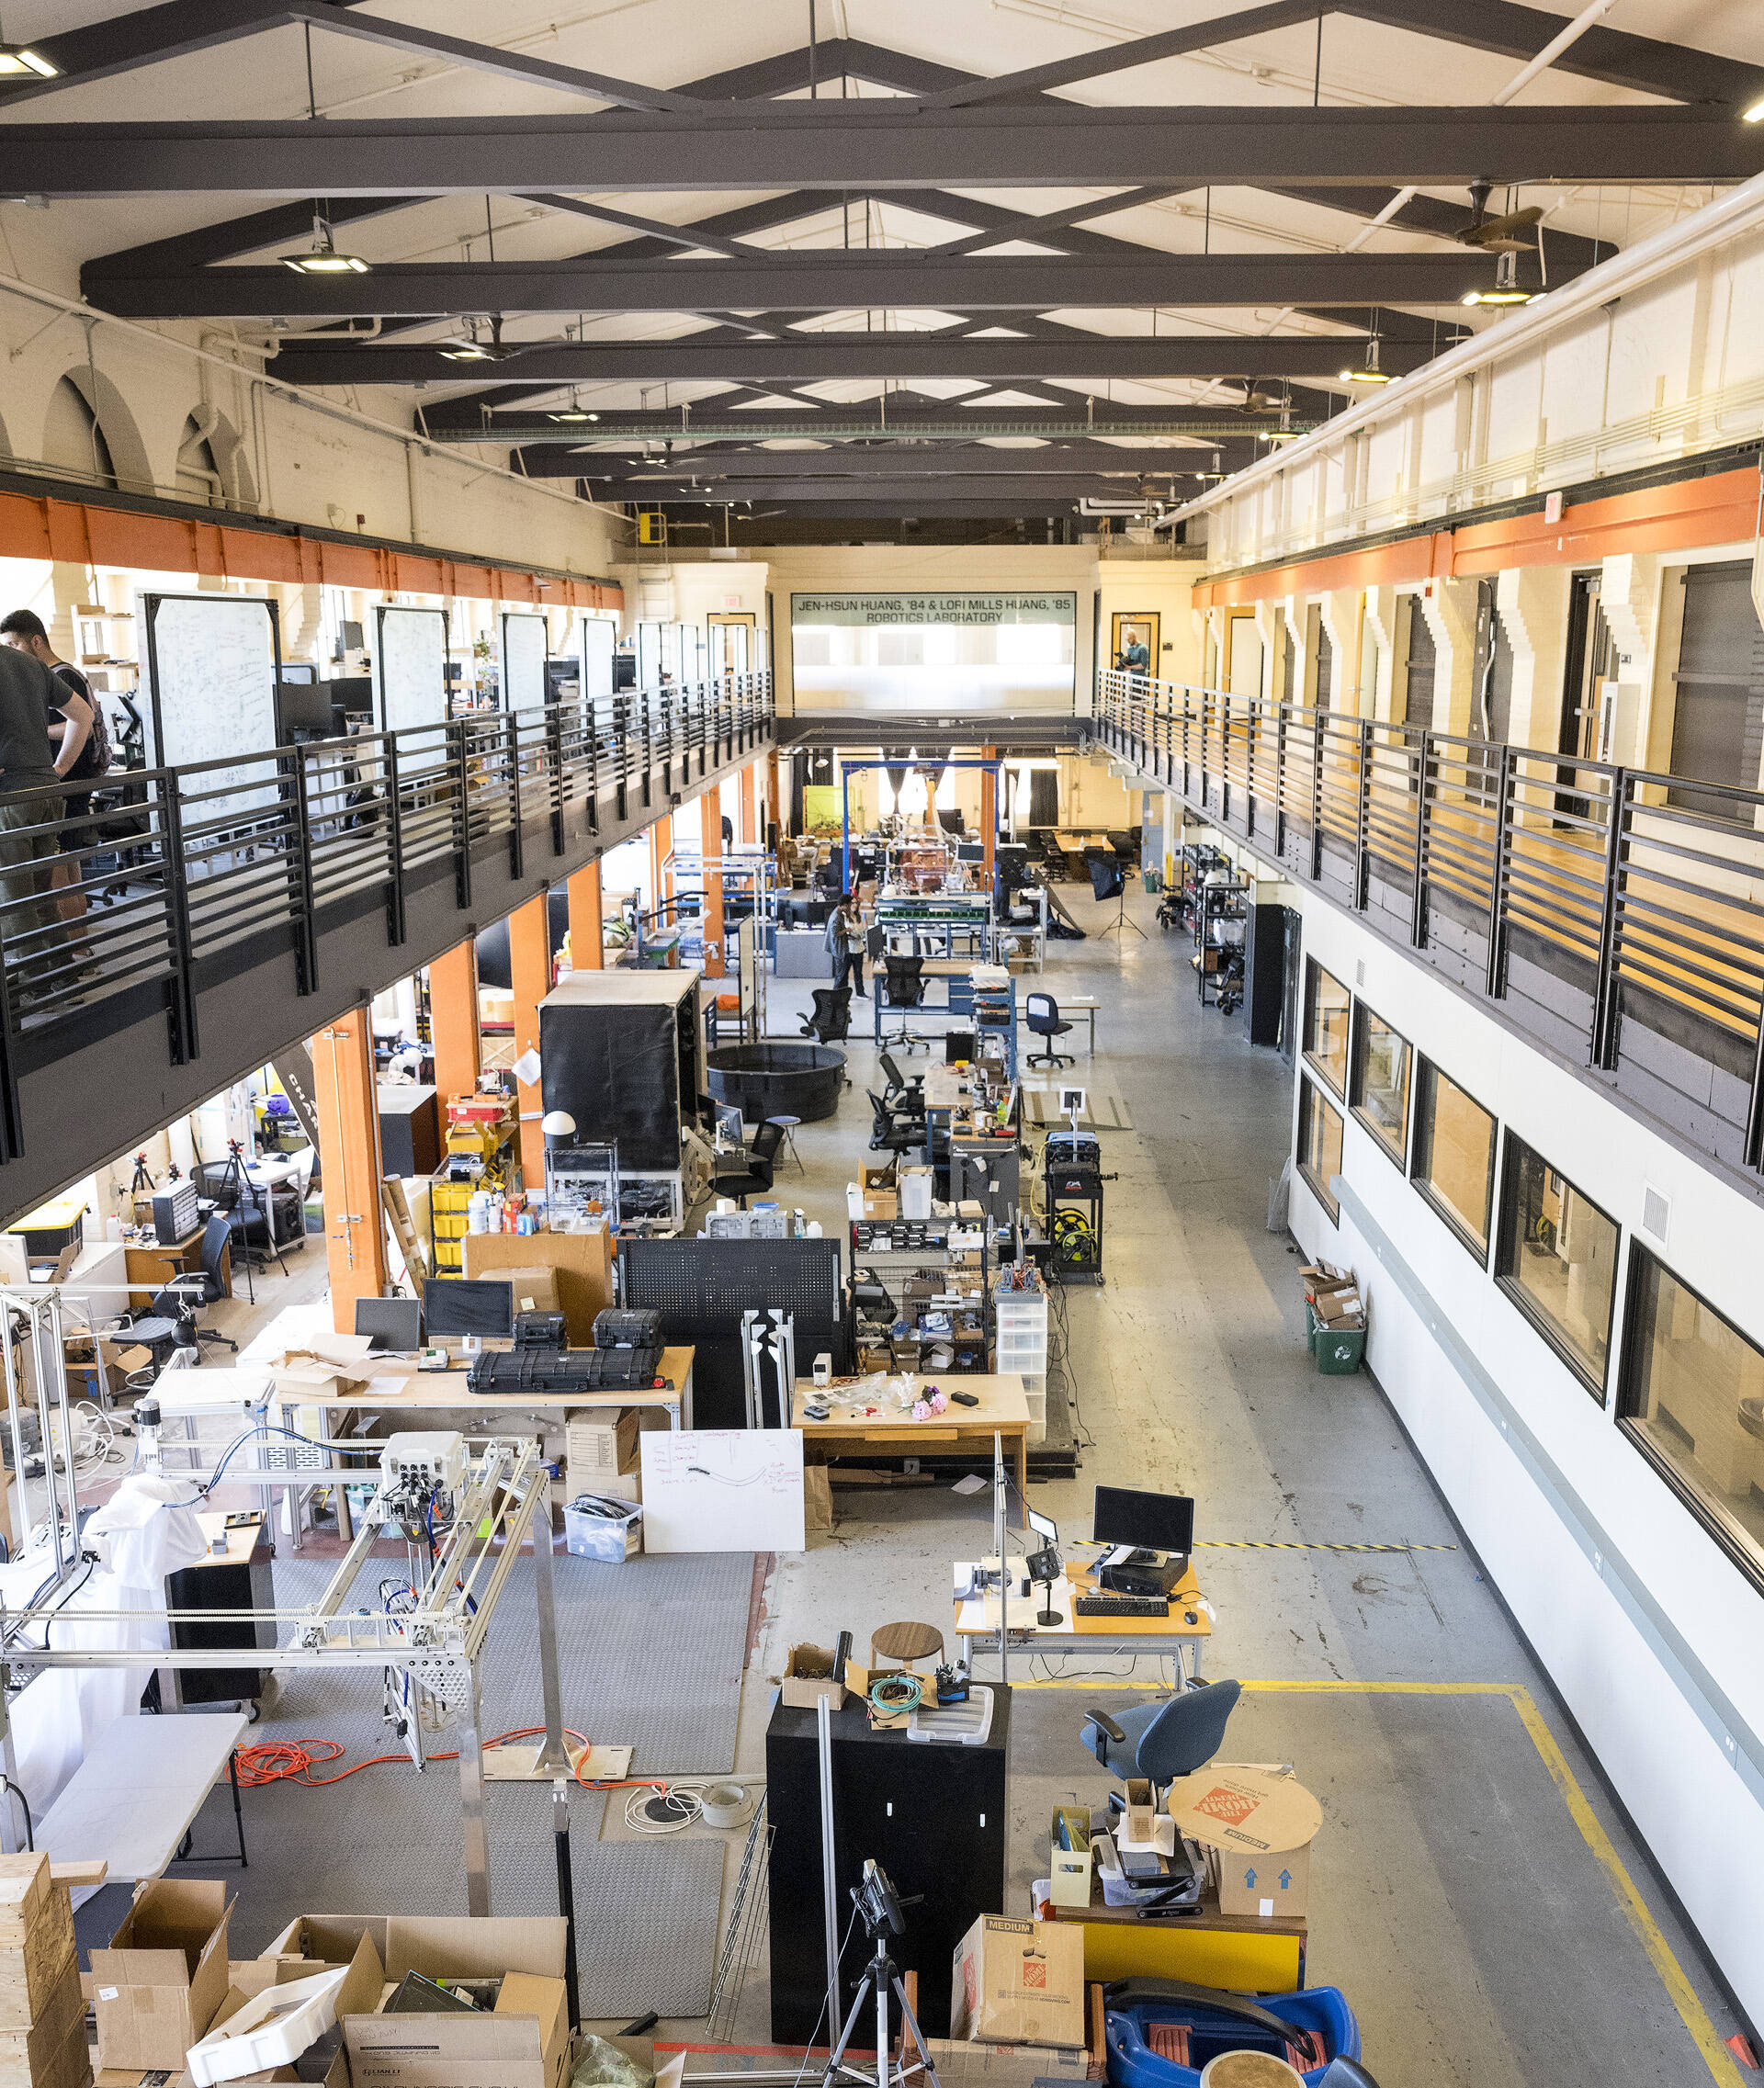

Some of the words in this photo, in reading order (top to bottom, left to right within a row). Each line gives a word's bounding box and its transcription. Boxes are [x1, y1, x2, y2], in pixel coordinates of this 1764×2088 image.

[798, 600, 858, 611] JEN-HSUN
[861, 600, 904, 611] HUANG,
[908, 600, 925, 610] '84
[928, 600, 937, 610] &
[968, 600, 1003, 610] MILLS
[1006, 600, 1049, 611] HUANG,
[1052, 599, 1070, 609] '85
[866, 613, 923, 623] ROBOTICS
[926, 613, 1002, 623] LABORATORY
[1227, 1830, 1266, 1848] MEDIUM
[989, 1919, 1030, 1933] MEDIUM
